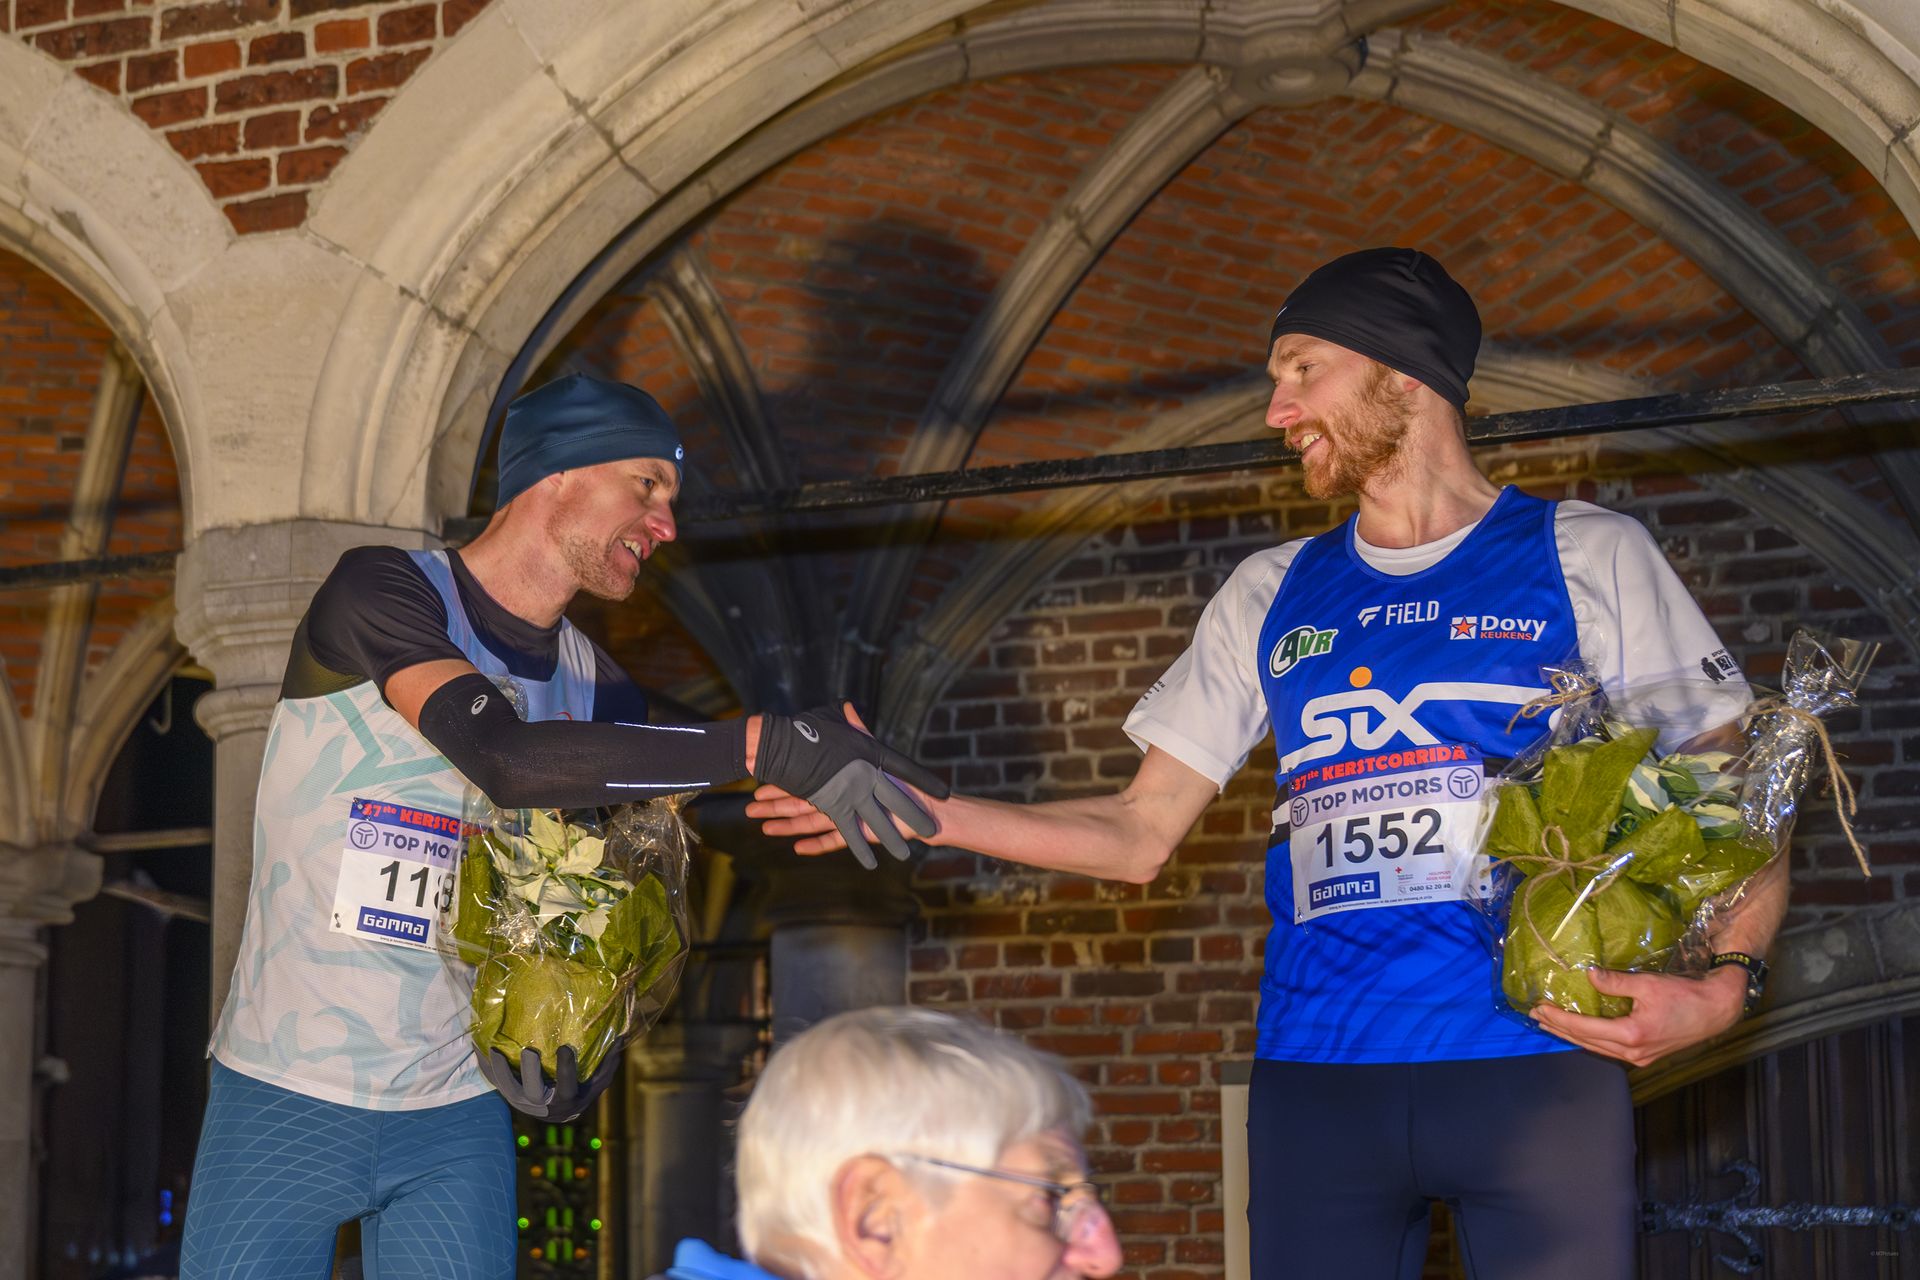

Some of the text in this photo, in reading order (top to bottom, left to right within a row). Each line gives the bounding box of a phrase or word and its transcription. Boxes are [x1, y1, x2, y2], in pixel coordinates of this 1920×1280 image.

[1480, 631, 1532, 640] KEUKENS
[1481, 615, 1547, 641] Dovy
[1271, 626, 1337, 675] AVR
[1322, 746, 1468, 781] KERSTCORRIDA
[1312, 777, 1443, 813] TOP MOTORS
[383, 831, 420, 851] TOP
[1317, 808, 1445, 868] 1552
